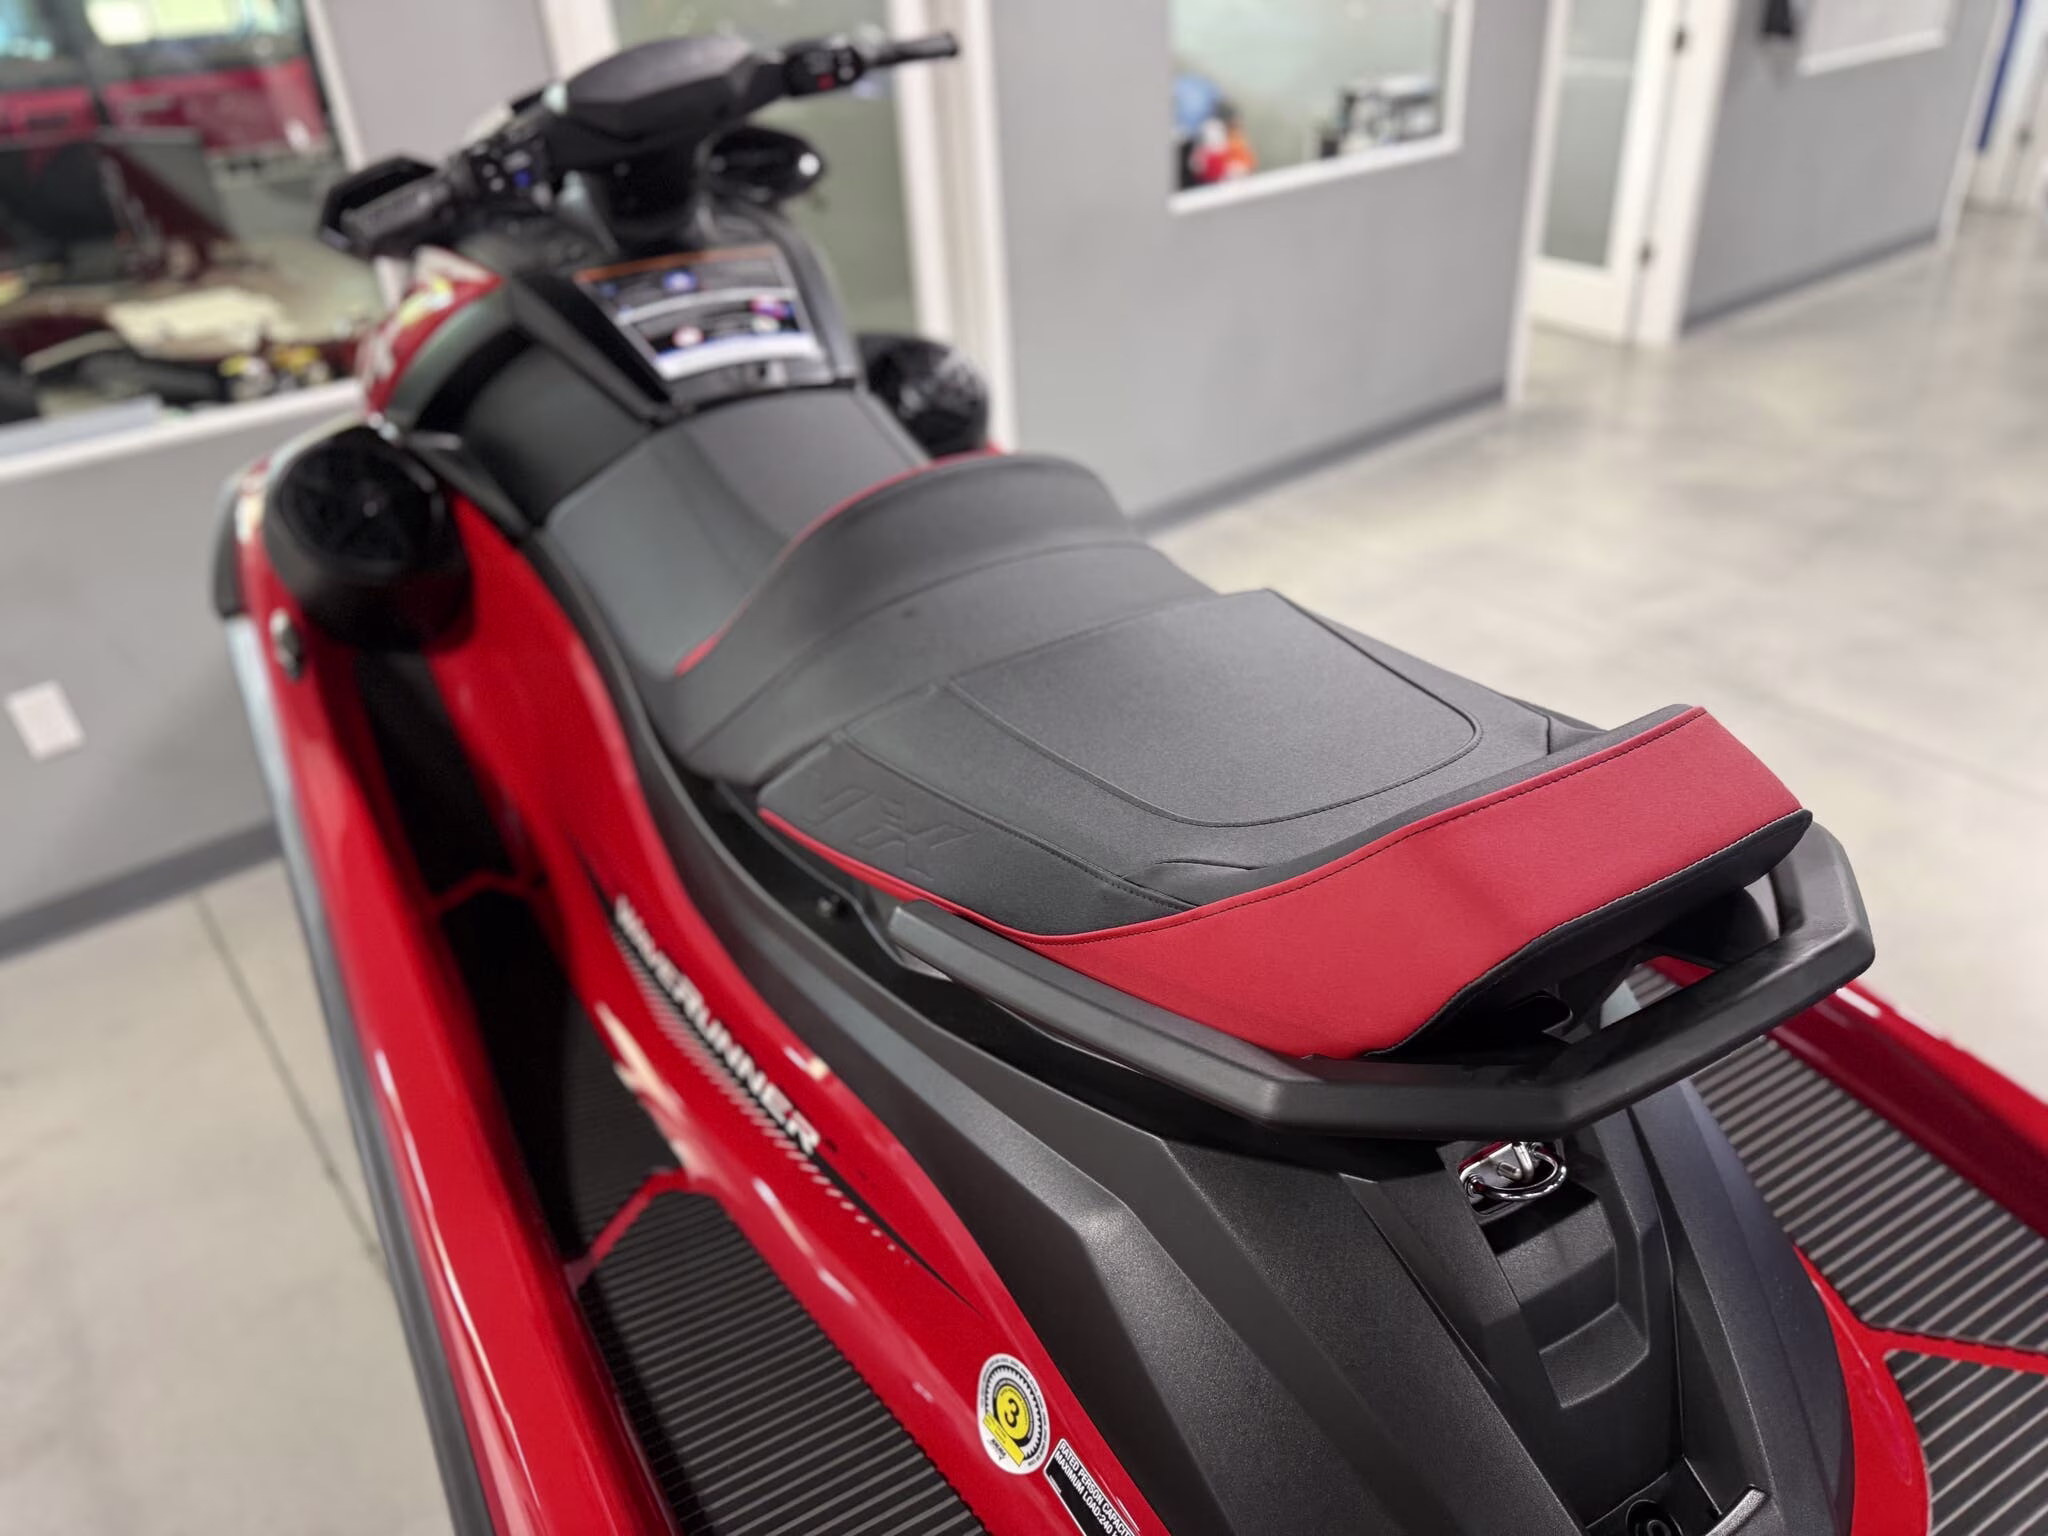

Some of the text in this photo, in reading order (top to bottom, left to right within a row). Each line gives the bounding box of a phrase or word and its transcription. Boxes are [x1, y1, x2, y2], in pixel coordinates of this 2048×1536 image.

[1005, 1398, 1019, 1428] 3
[1055, 1451, 1084, 1494] MAXIMUM
[1082, 1491, 1112, 1533] LOAD:240
[1059, 1442, 1079, 1471] RATED
[1077, 1468, 1103, 1505] PERSON
